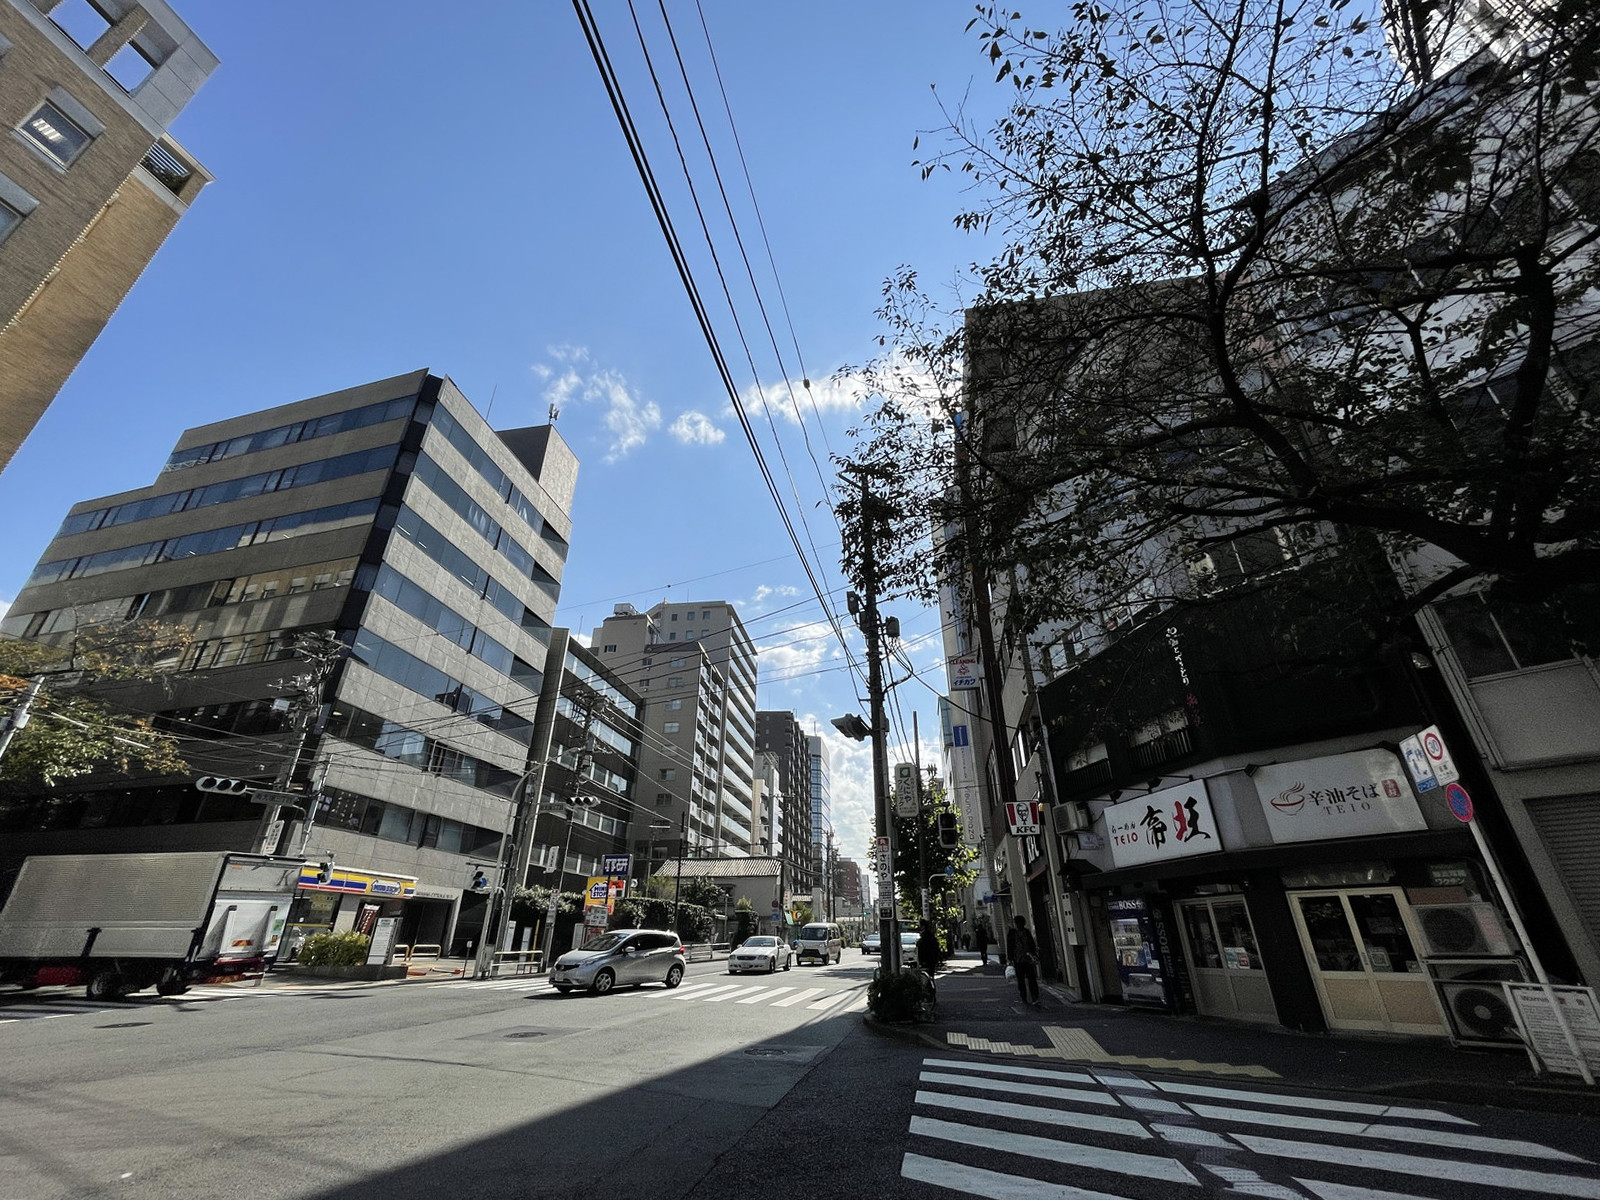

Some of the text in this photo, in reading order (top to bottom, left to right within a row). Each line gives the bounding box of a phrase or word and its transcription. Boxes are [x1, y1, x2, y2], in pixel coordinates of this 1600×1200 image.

[904, 778, 912, 803] くにや
[1308, 783, 1381, 806] 辛油そば
[1323, 802, 1371, 815] TEIO
[1112, 821, 1136, 834] らーめん
[1114, 832, 1138, 846] TEIO
[880, 854, 888, 880] さのや
[1118, 900, 1136, 910] BOSS
[1155, 921, 1170, 954] BOSS
